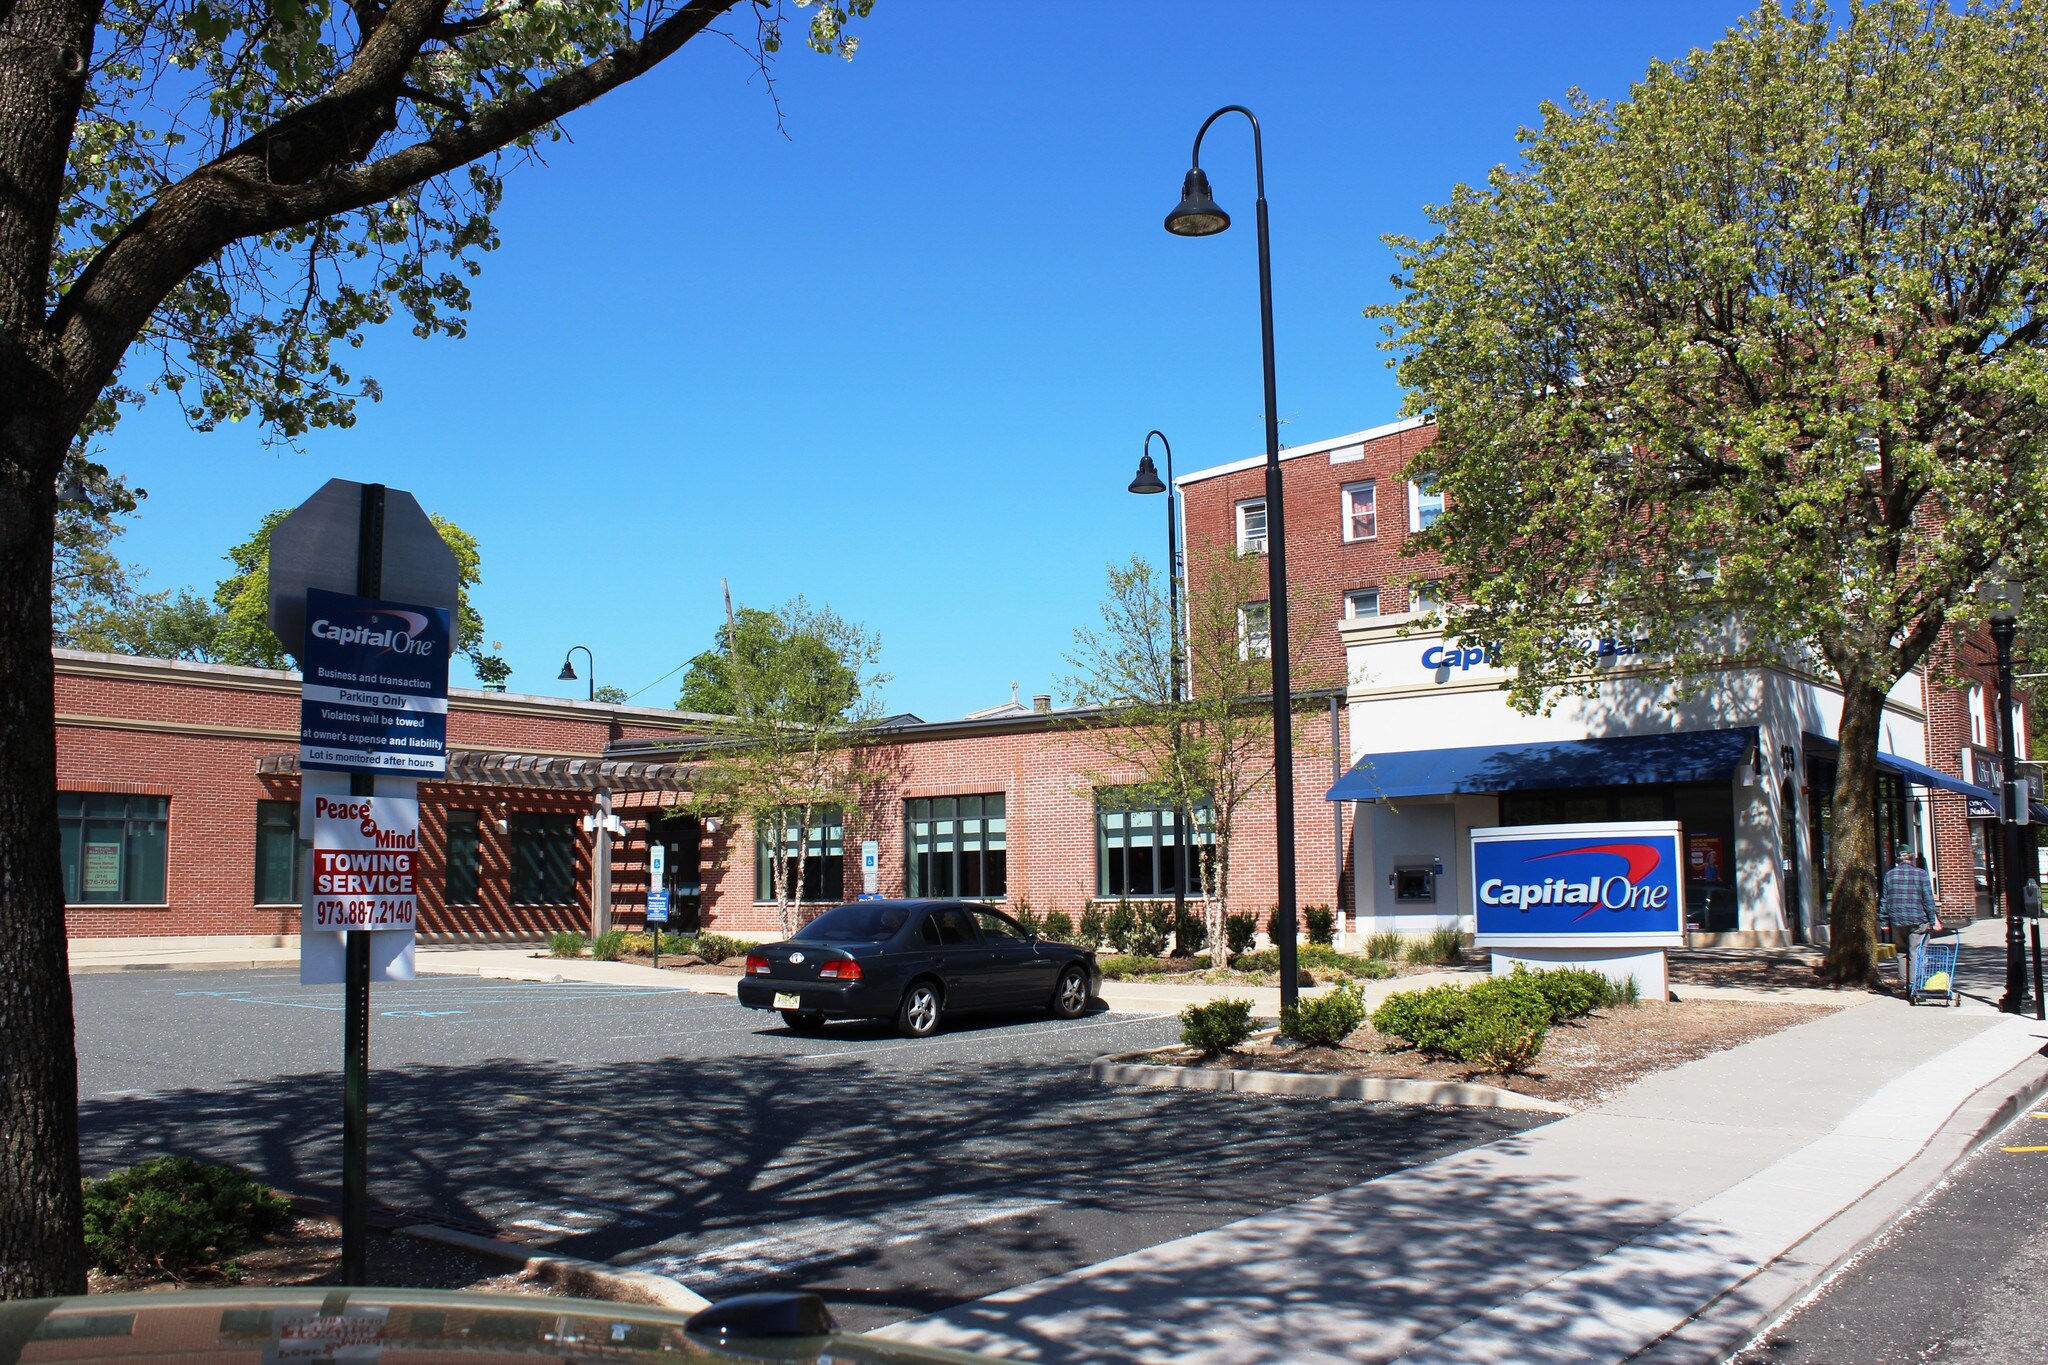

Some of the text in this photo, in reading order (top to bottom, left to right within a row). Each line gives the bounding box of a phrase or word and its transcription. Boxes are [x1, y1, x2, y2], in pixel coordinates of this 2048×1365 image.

[318, 667, 431, 689] Business and transaction
[339, 690, 407, 708] Parking Only
[321, 709, 424, 728] Violators will be towed
[302, 729, 443, 750] at owner's expense and liability
[310, 749, 434, 768] Lot is monitored after hours
[315, 797, 370, 820] Peace
[1969, 807, 1991, 815] Nails
[375, 829, 416, 849] Mind
[321, 853, 410, 872] TOWING
[318, 874, 413, 893] SERVICE
[317, 900, 413, 925] 973.887.2140
